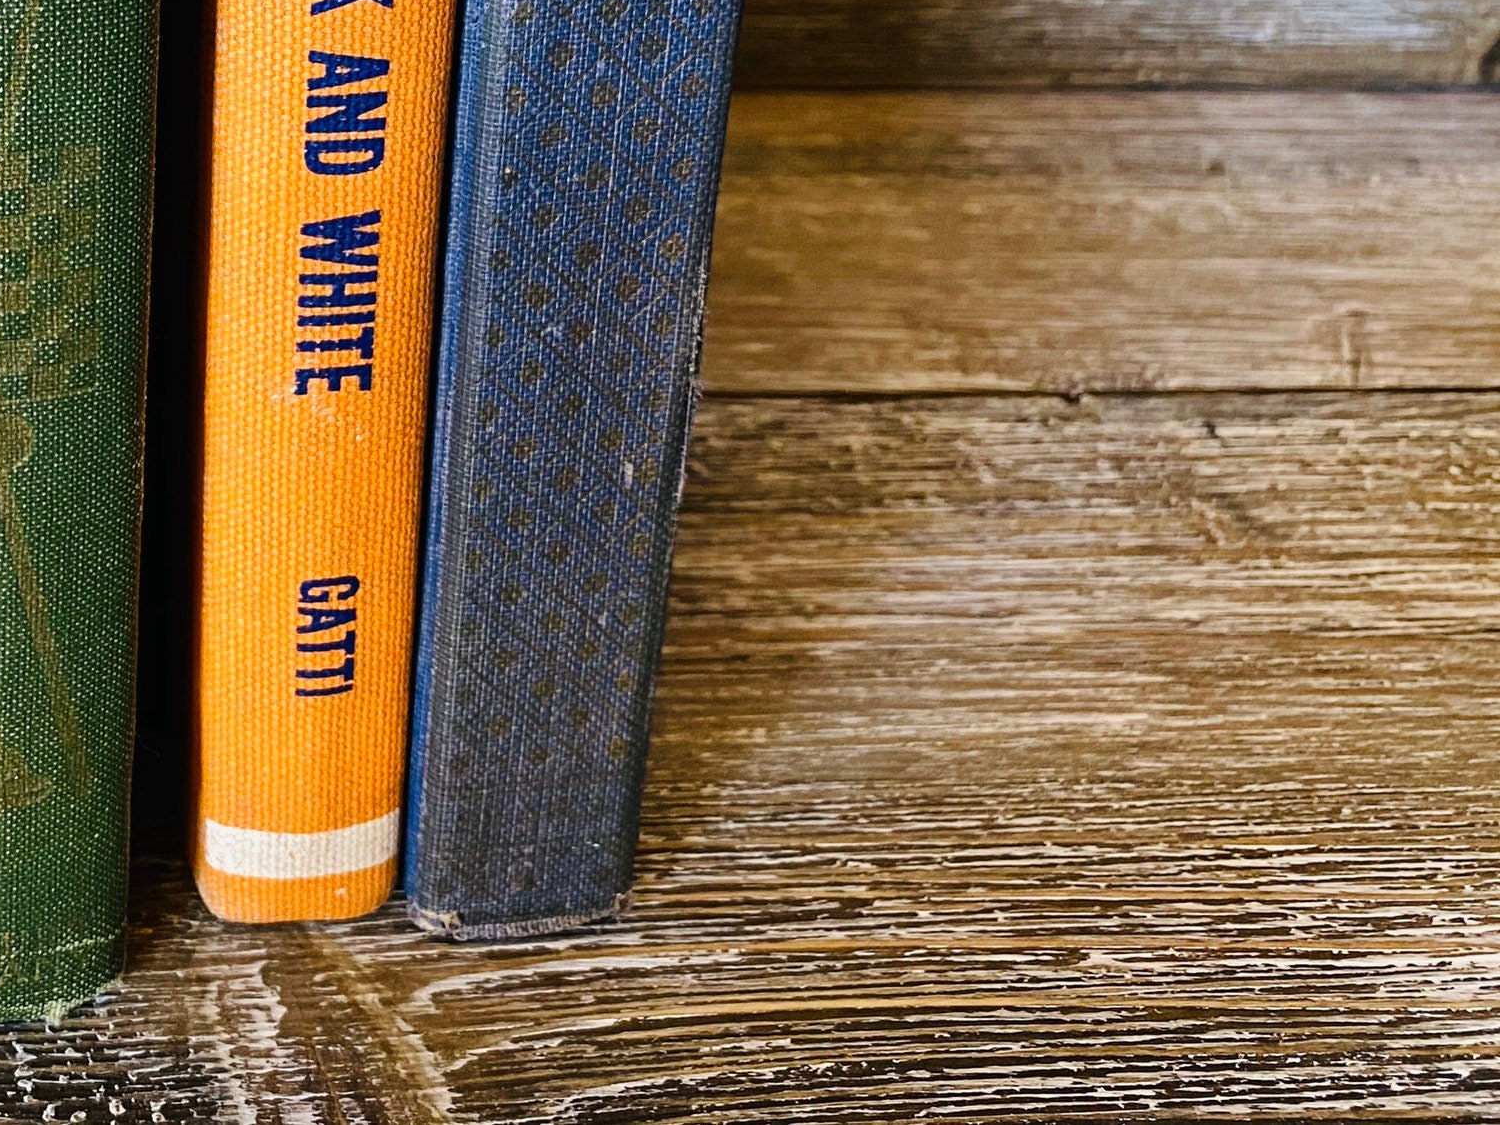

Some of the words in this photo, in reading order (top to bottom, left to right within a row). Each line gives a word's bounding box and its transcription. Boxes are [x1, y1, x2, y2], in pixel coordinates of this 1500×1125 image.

[303, 49, 391, 177] AND
[293, 209, 382, 396] WHITE
[294, 575, 361, 698] GATTI
